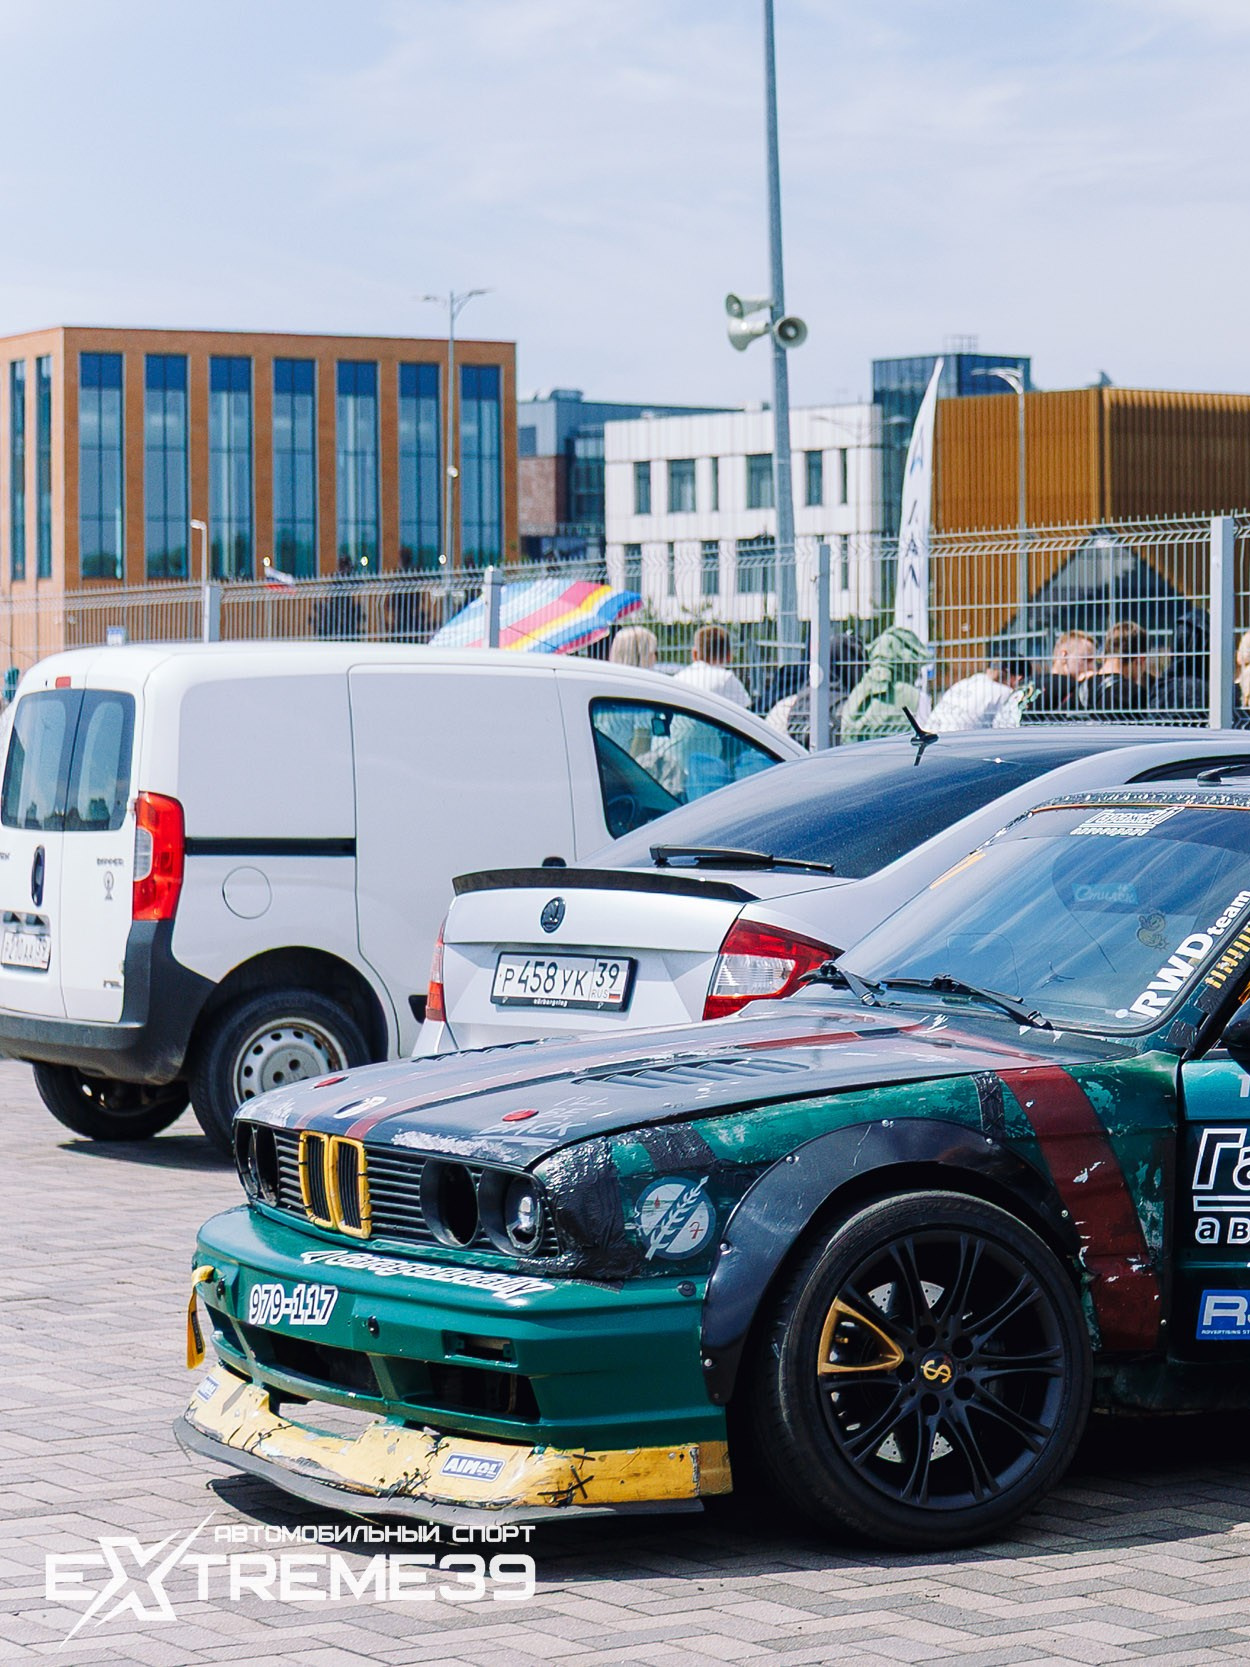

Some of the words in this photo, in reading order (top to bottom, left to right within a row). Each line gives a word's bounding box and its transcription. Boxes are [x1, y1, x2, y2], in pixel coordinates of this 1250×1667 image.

[595, 962, 621, 989] 39
[591, 988, 609, 999] RUS
[249, 1283, 339, 1325] 979-117
